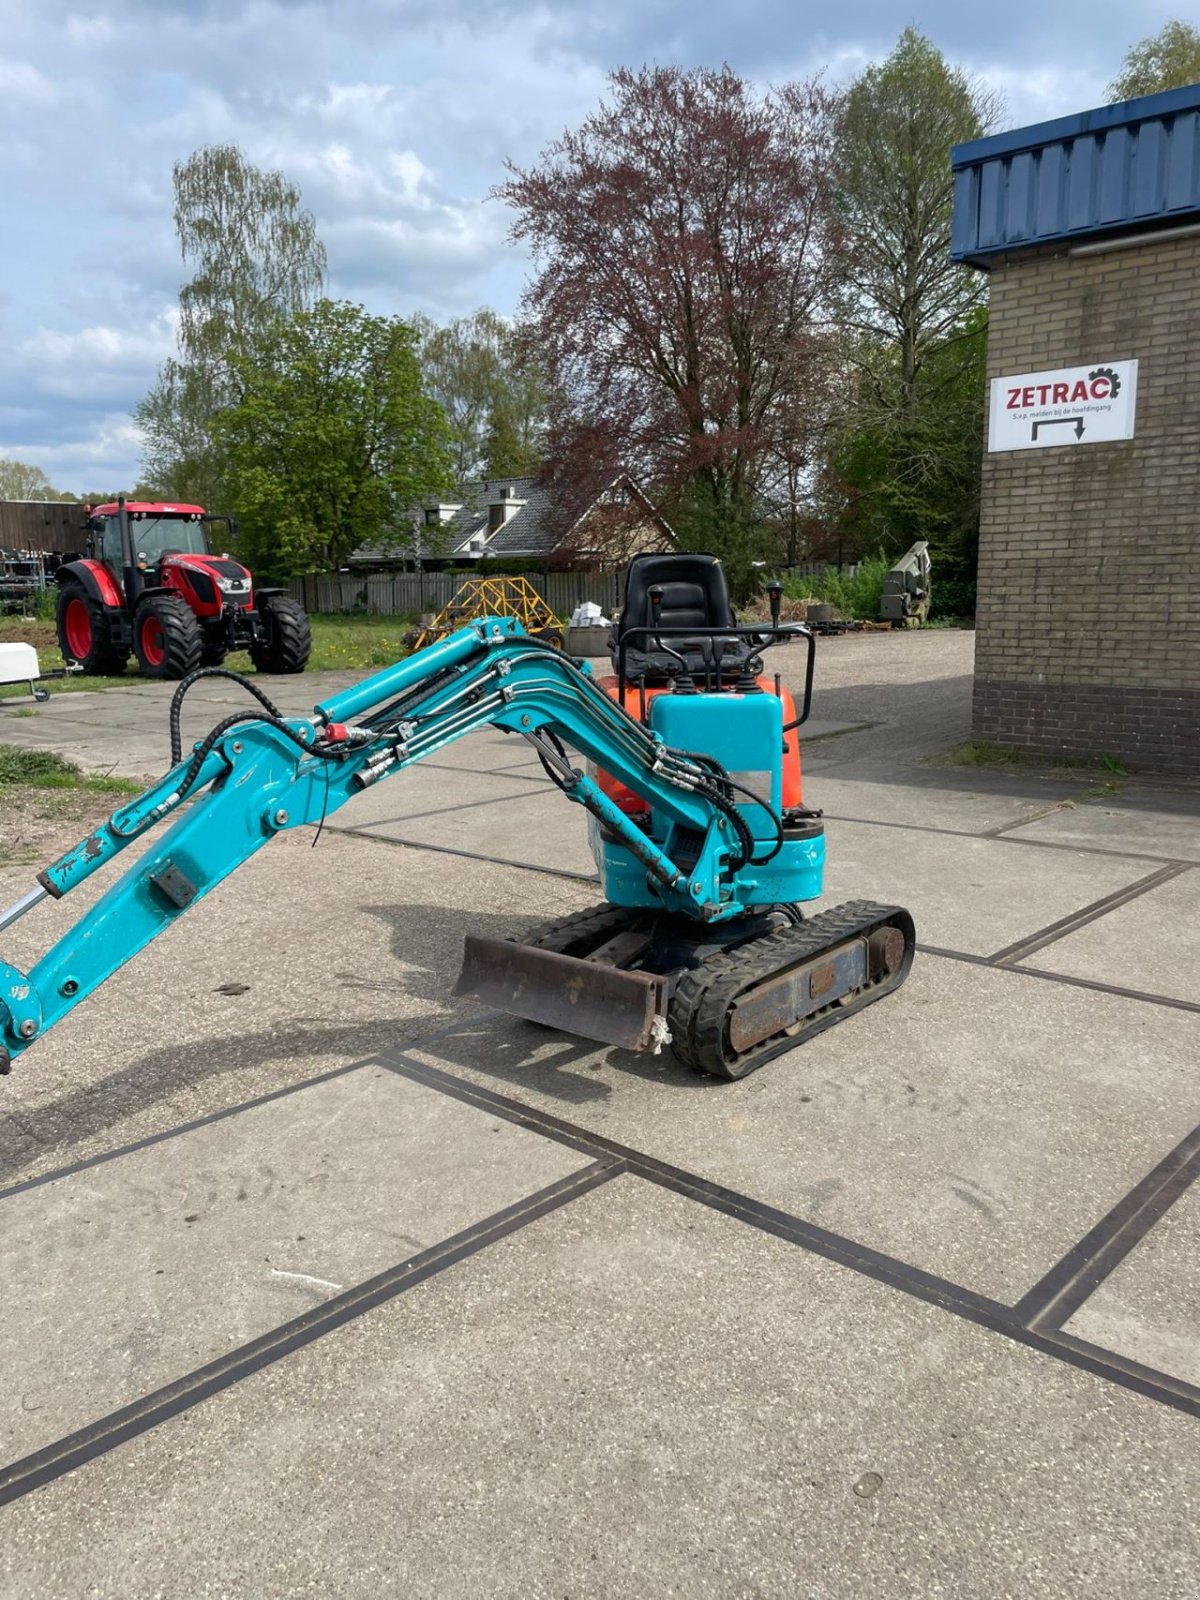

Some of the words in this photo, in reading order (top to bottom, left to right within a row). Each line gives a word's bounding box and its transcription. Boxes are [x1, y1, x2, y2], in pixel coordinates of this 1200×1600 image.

[1006, 378, 1110, 409] ZETRAC
[1030, 410, 1052, 418] melden
[1054, 408, 1062, 417] bij
[1072, 404, 1112, 413] hoofdingang
